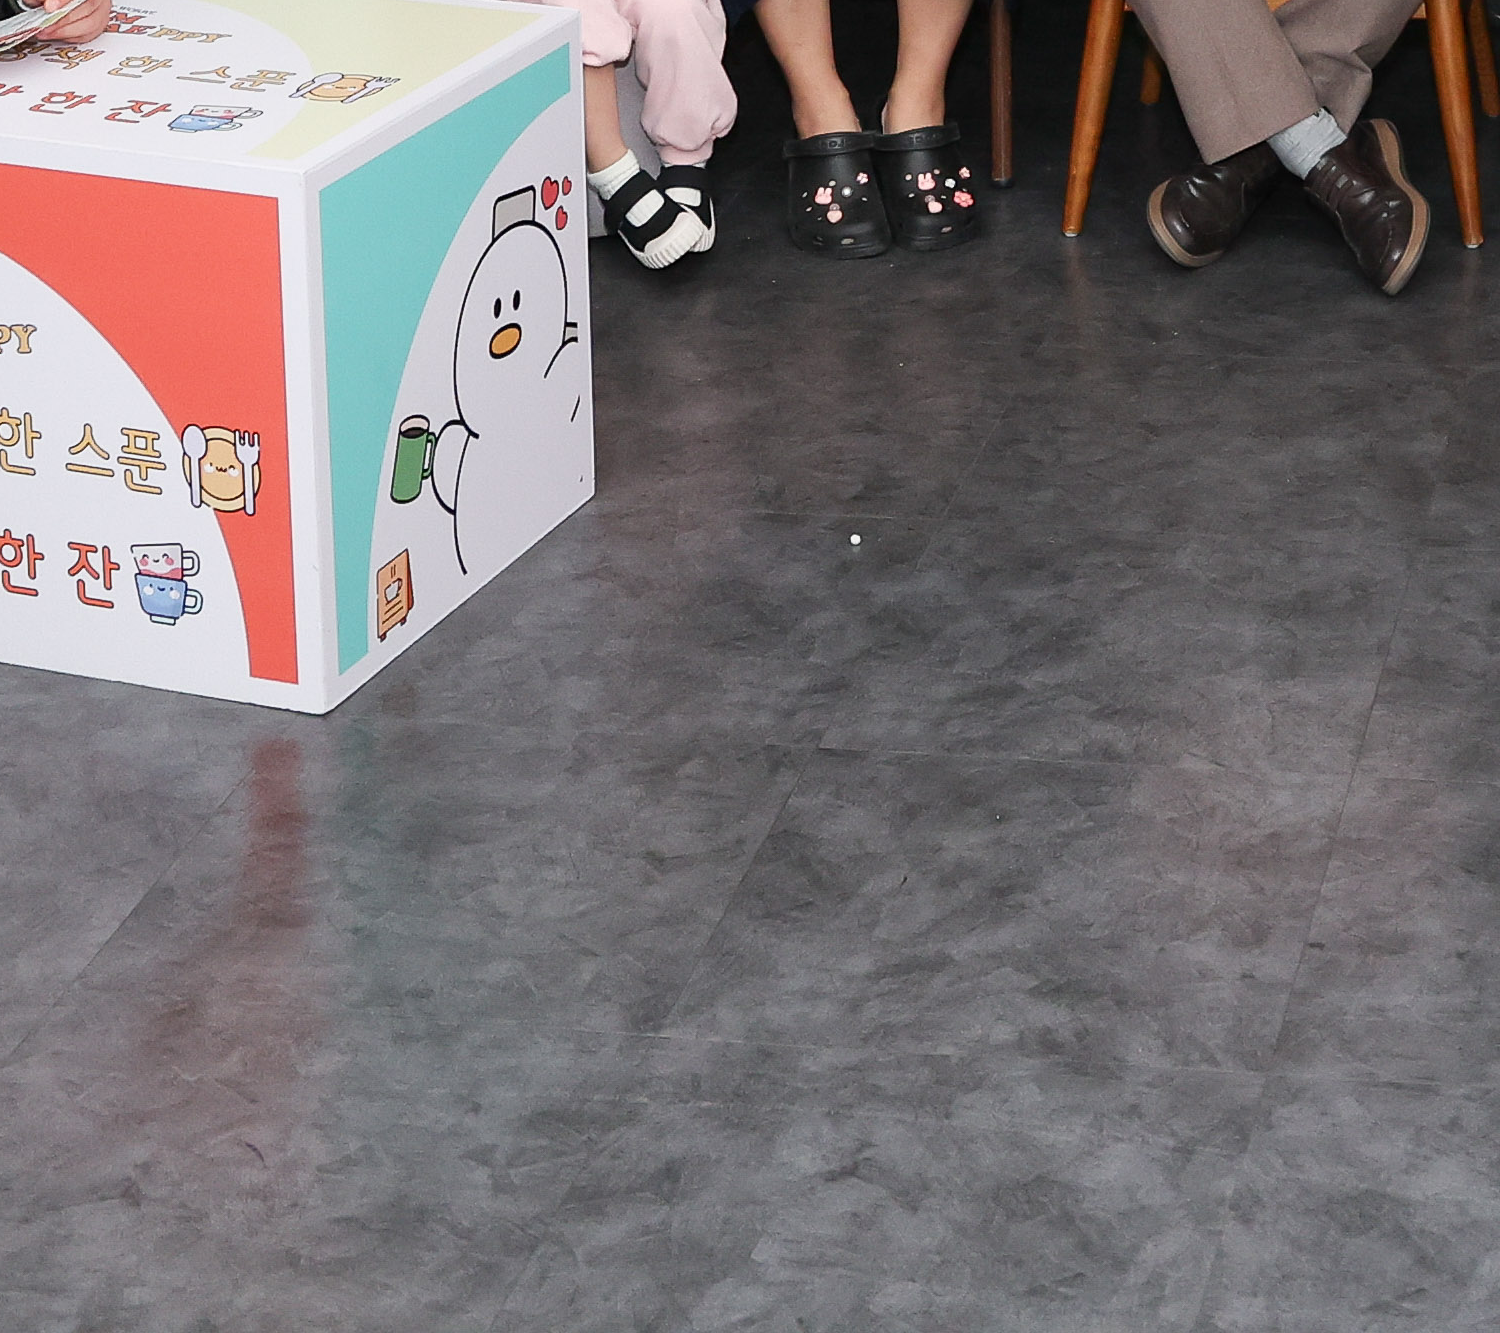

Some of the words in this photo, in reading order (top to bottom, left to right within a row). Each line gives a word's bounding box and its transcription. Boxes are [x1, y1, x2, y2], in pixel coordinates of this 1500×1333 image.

[108, 55, 173, 78] 한
[176, 66, 296, 92] 스푼
[29, 91, 97, 114] 한
[104, 100, 172, 123] 잔
[65, 423, 167, 495] 스푼
[67, 541, 121, 609] 잔
